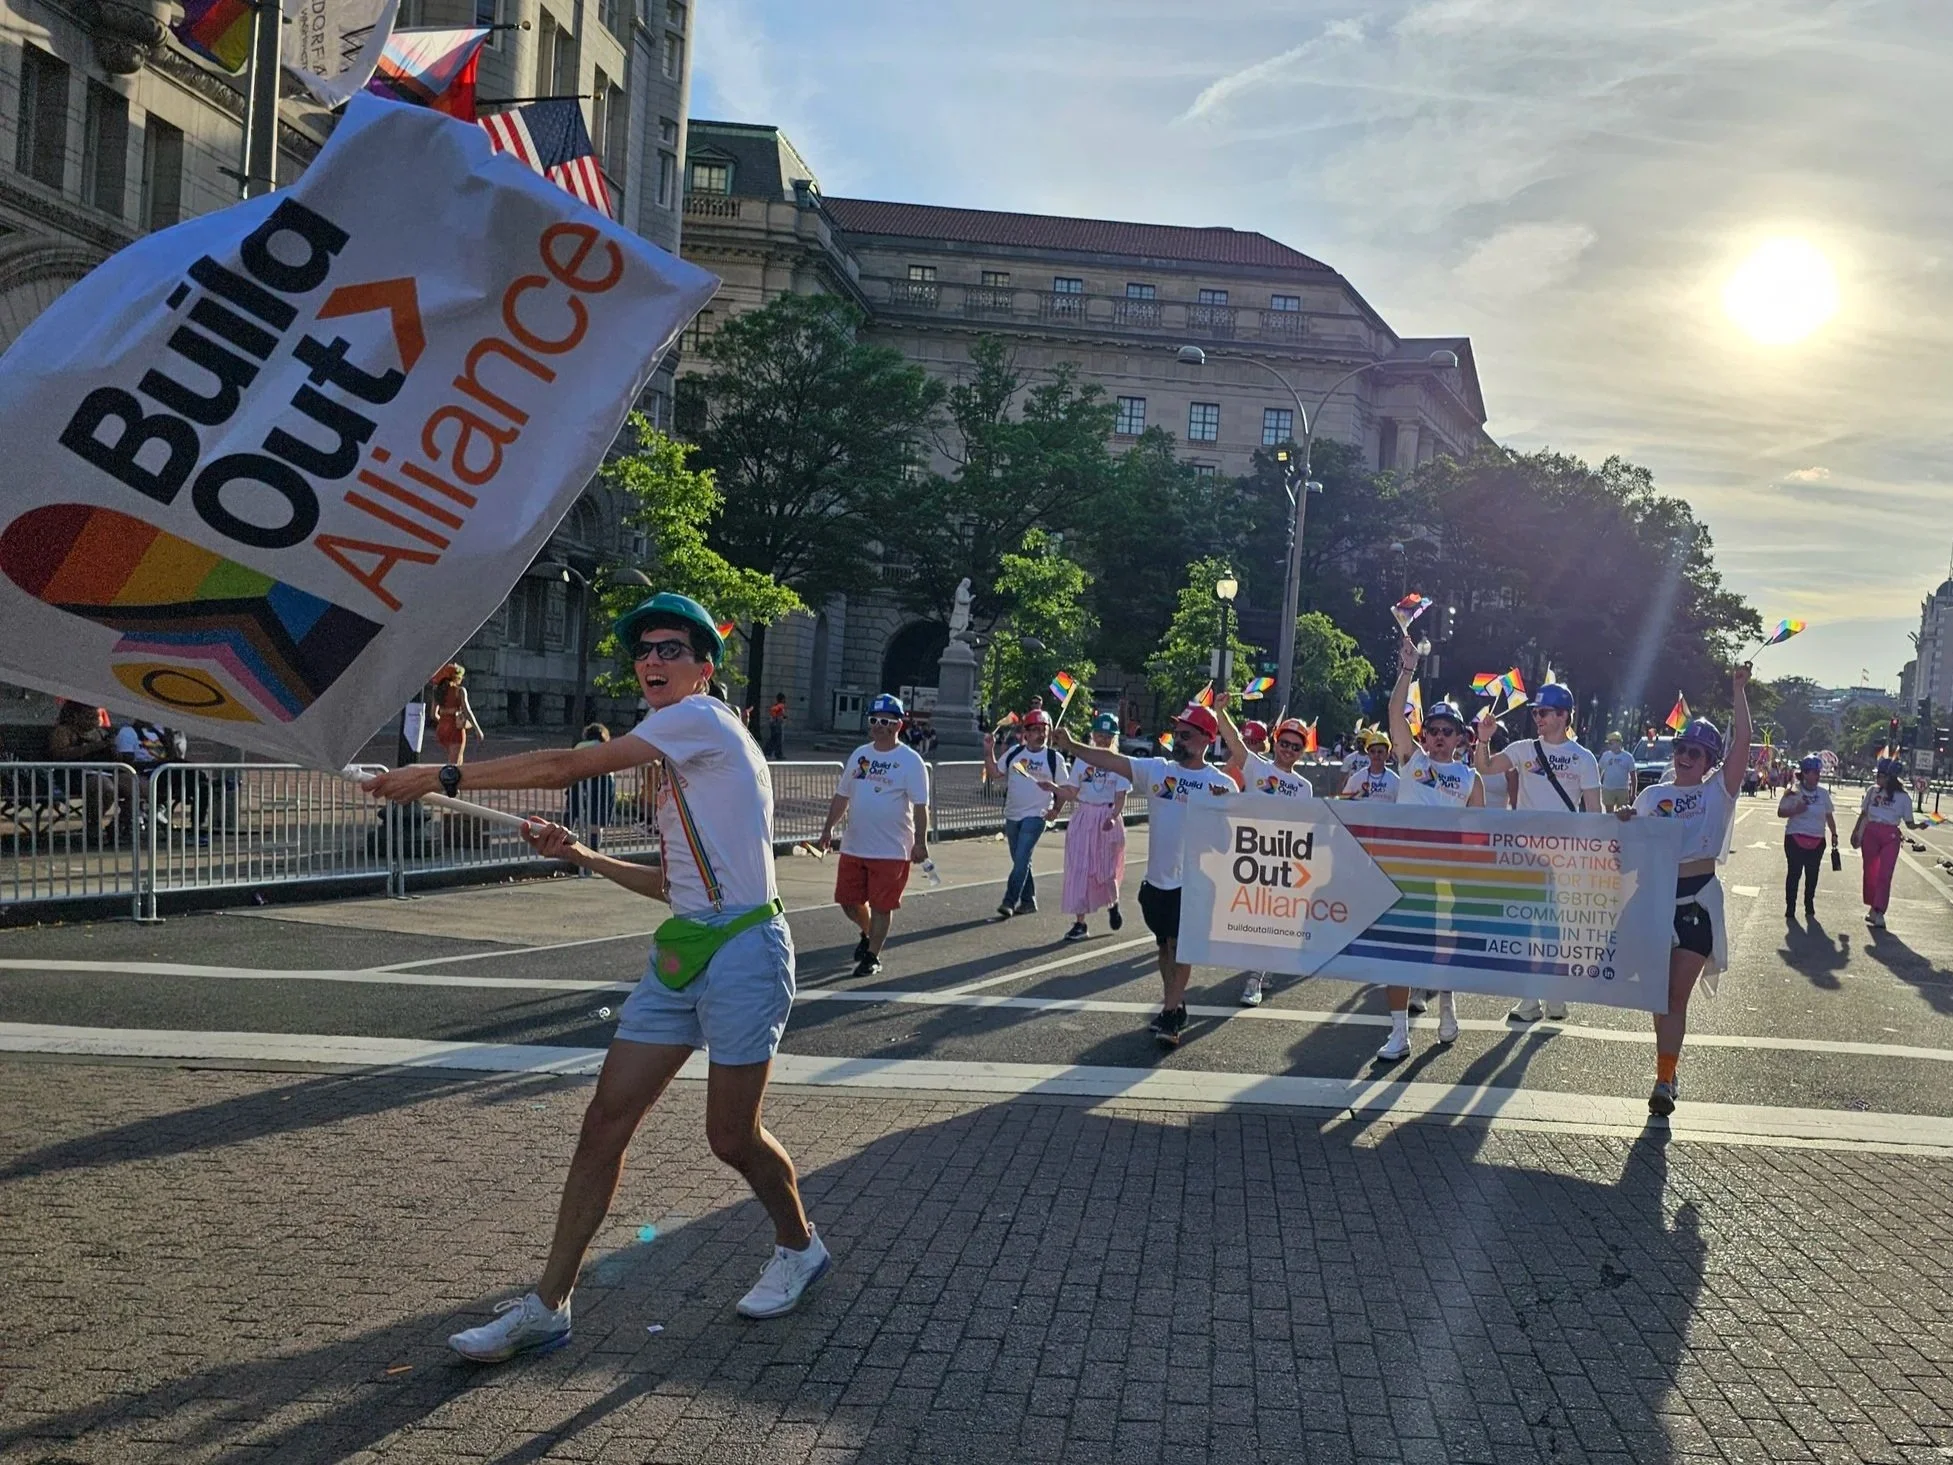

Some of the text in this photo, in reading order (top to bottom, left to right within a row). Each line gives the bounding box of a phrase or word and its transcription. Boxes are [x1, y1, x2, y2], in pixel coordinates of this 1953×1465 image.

[58, 197, 350, 506] Build
[314, 221, 625, 612] Alliance
[192, 334, 407, 549] Out
[1549, 754, 1571, 764] Build
[1176, 786, 1189, 795] Ou
[1179, 778, 1203, 790] Build
[1235, 825, 1314, 861] Build
[1492, 833, 1621, 854] PROMOTING &
[1232, 855, 1292, 888] Out
[1498, 852, 1621, 872] ADVOCATING
[1547, 871, 1621, 890] FOR THE
[1230, 885, 1348, 923] Alliance
[1548, 889, 1619, 909] LGBTQ+
[1506, 905, 1618, 925] COMMUNITY
[1227, 923, 1312, 940] buildoutalliance.org
[1562, 927, 1617, 945] IN THE
[1488, 939, 1617, 962] AEC INDUSTRY
